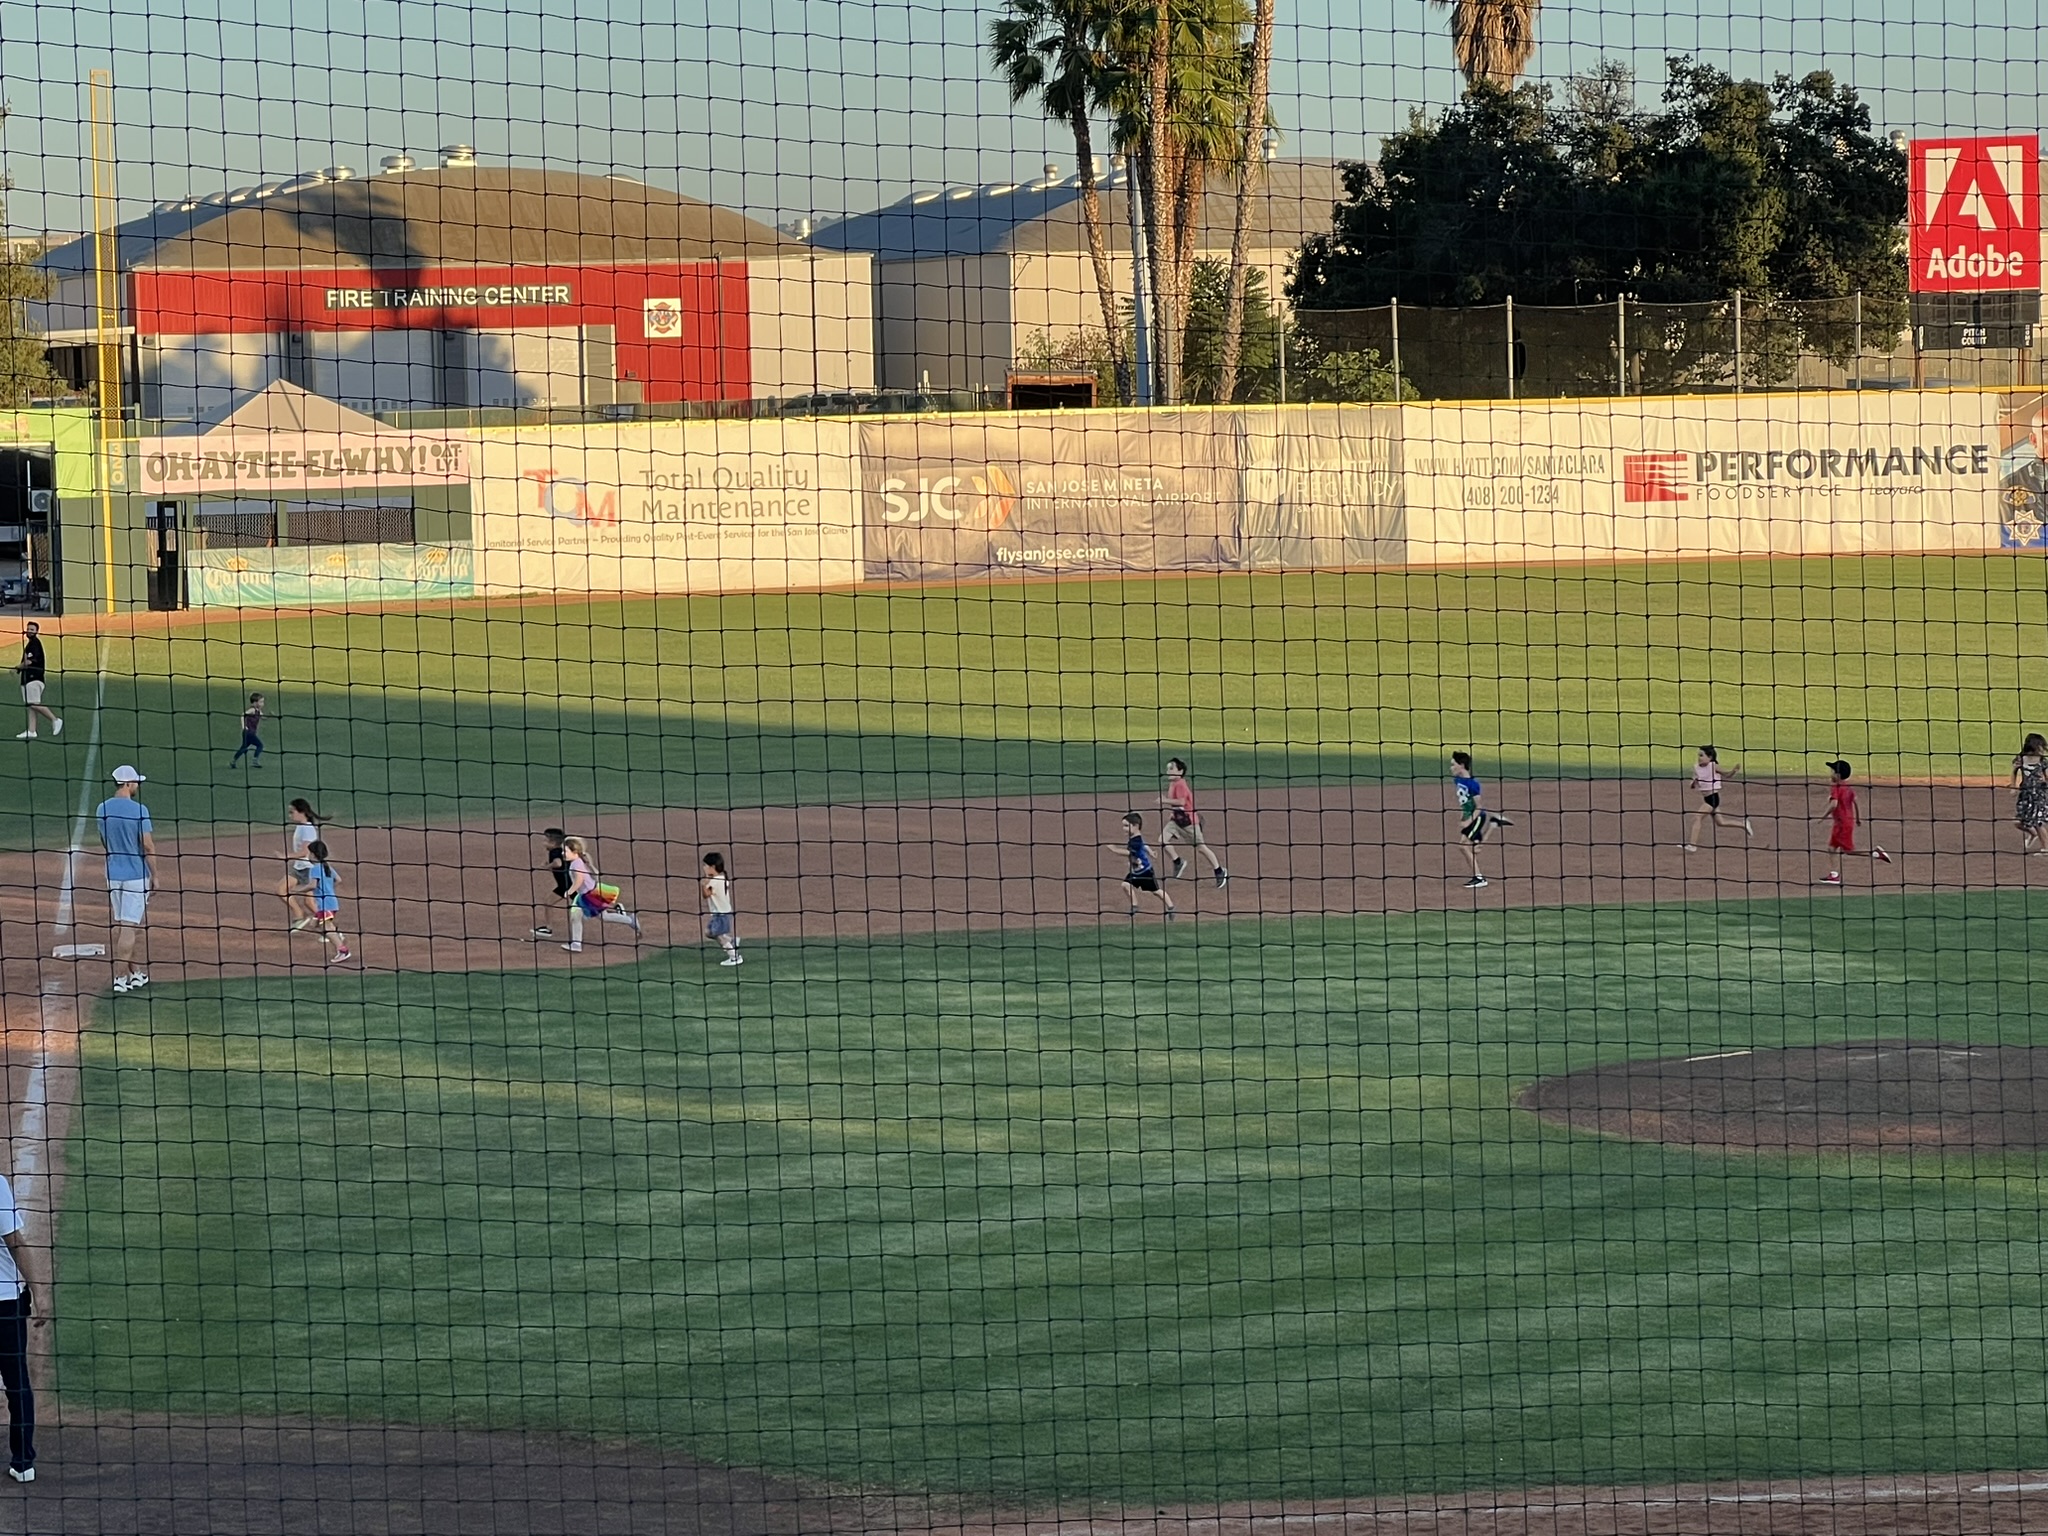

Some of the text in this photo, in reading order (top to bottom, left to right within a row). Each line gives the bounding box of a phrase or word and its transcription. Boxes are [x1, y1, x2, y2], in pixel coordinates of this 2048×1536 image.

[1926, 244, 2023, 279] Adobe
[327, 285, 569, 307] FIRE TRAINING CENTER
[1963, 328, 1986, 336] PITCH
[111, 442, 124, 485] 320
[146, 445, 427, 482] OH-AY-TEE-EL-WHY!
[1414, 454, 1605, 477] WWWHYATT.COM/SANTACLARA
[1696, 444, 1989, 482] PERFORMANCE
[639, 464, 808, 494] Total Quality
[1026, 478, 1163, 494] SAN JOSE MNETA
[880, 475, 963, 522] SJC
[1027, 492, 1221, 510] INTERNATIONAL AIRPORT
[1463, 485, 1559, 506] 408 200-1234
[1696, 484, 1842, 500] FOODSERVICE
[526, 538, 555, 547] Servic
[558, 536, 588, 545] Partne
[600, 534, 641, 544] Provding
[676, 531, 721, 541] Pst-Even
[724, 529, 755, 539] Service
[758, 528, 769, 538] for
[787, 527, 803, 537] San
[821, 526, 849, 536] Giants
[996, 546, 1109, 564] flysanjose.com
